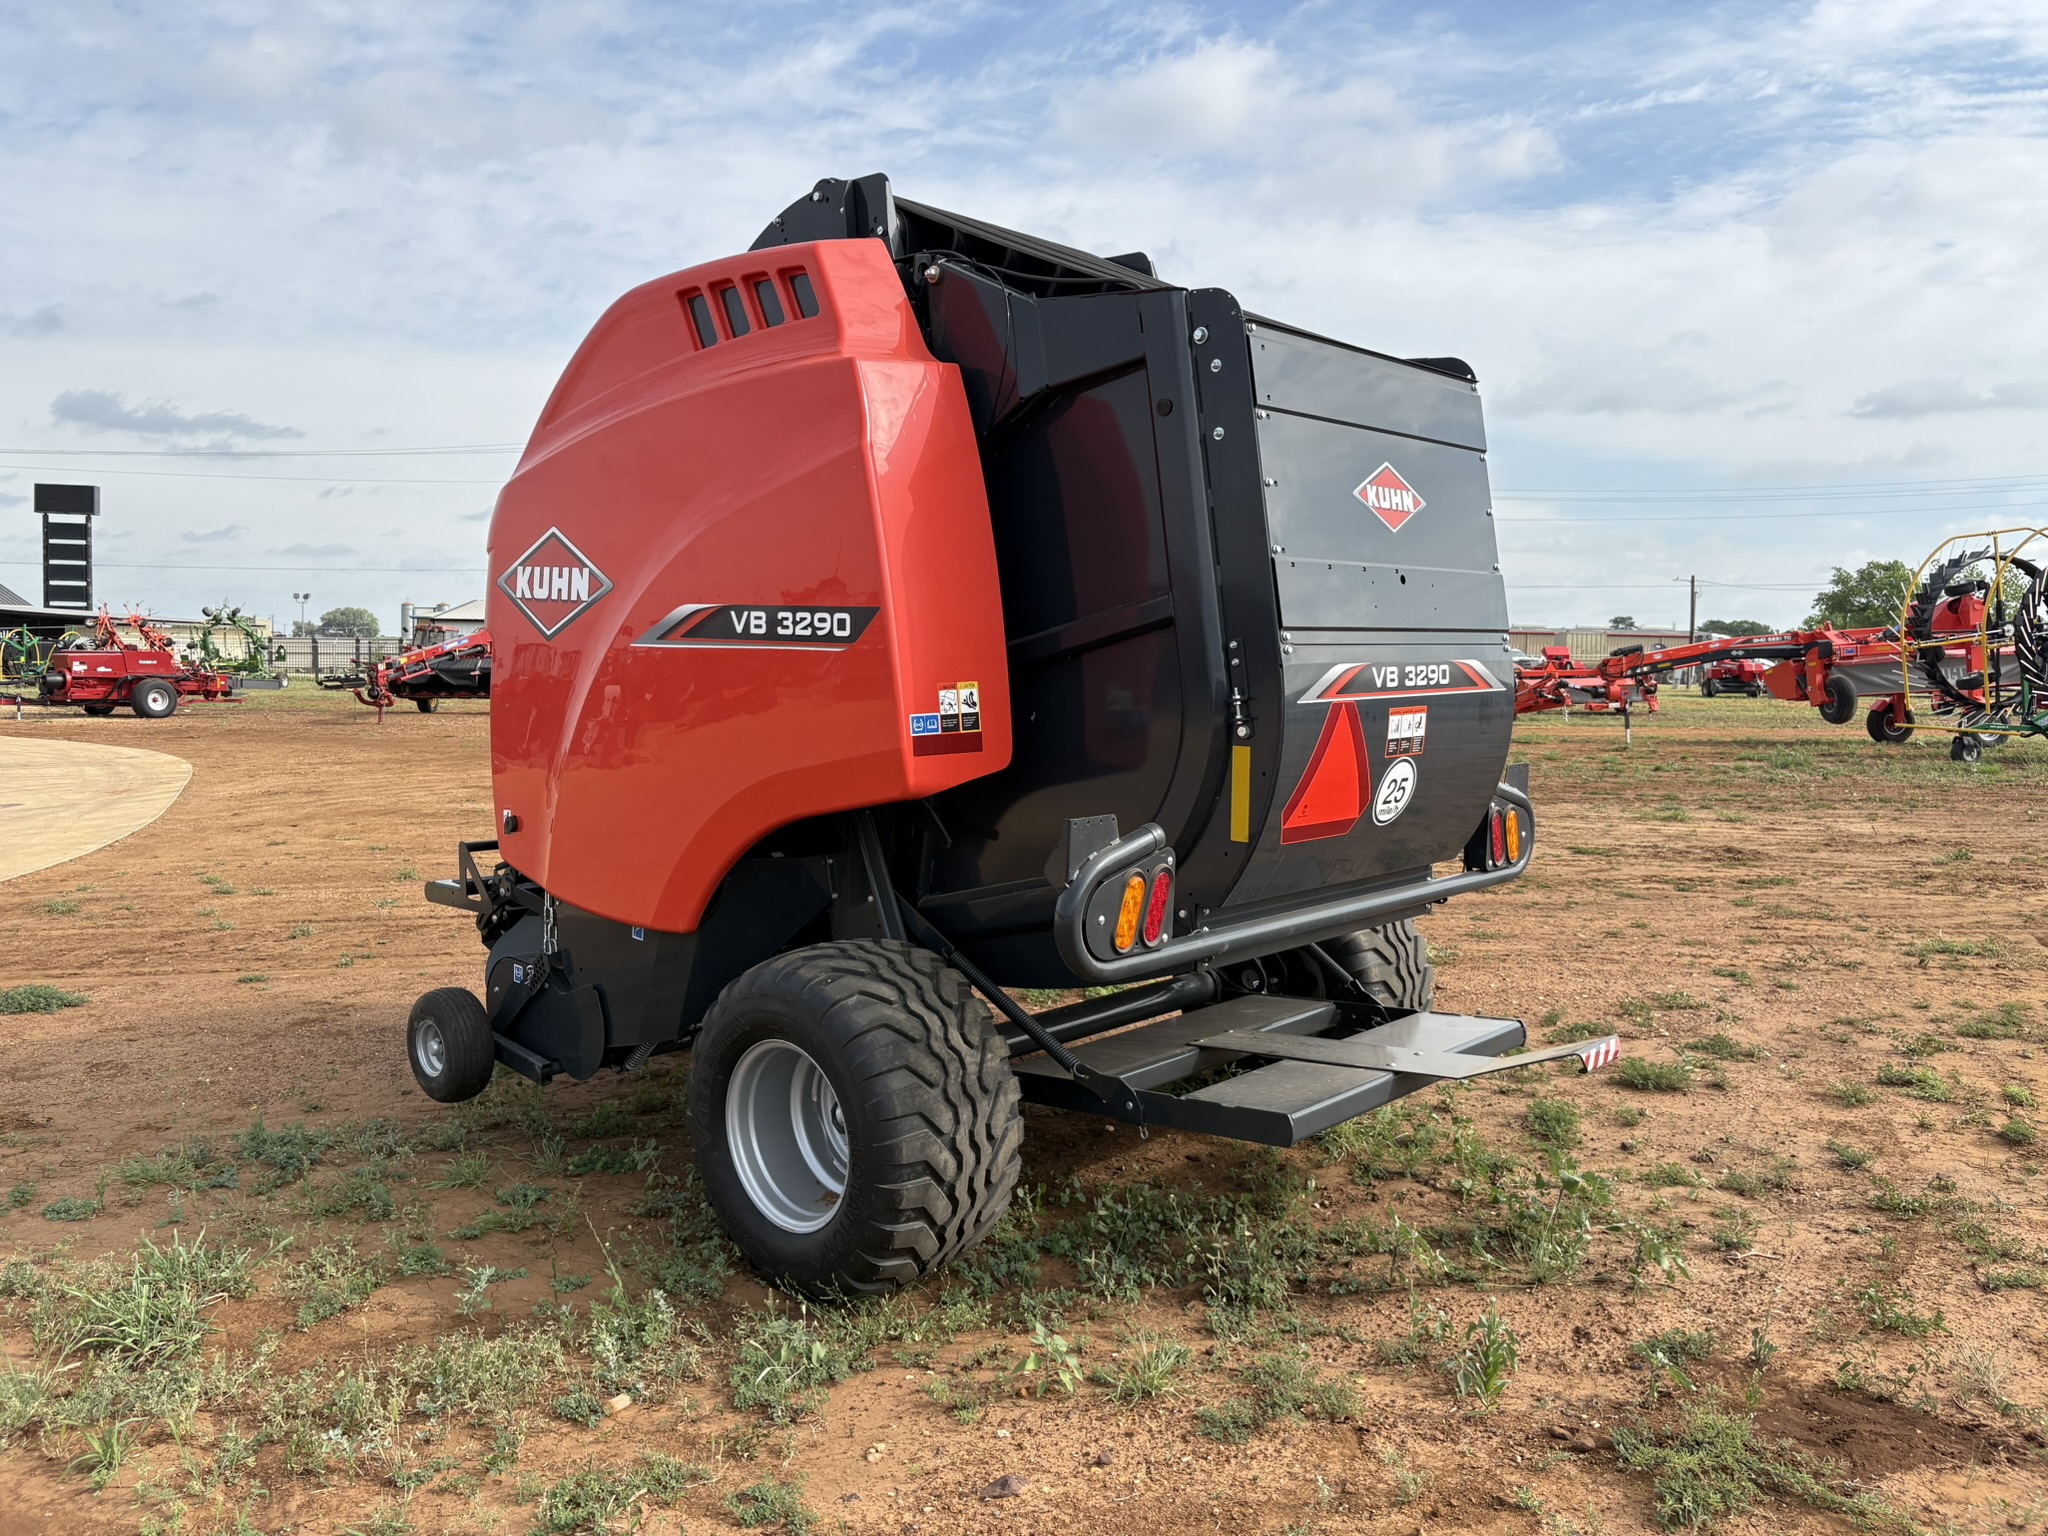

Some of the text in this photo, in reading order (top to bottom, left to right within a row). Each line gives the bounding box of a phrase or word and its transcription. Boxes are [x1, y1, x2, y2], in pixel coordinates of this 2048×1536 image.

[1366, 484, 1415, 513] KUHN
[515, 565, 591, 603] KUHN
[729, 610, 851, 638] VB 3290
[1371, 664, 1450, 688] VB 3290
[1381, 777, 1409, 805] 25
[1377, 804, 1399, 816] mile/h
